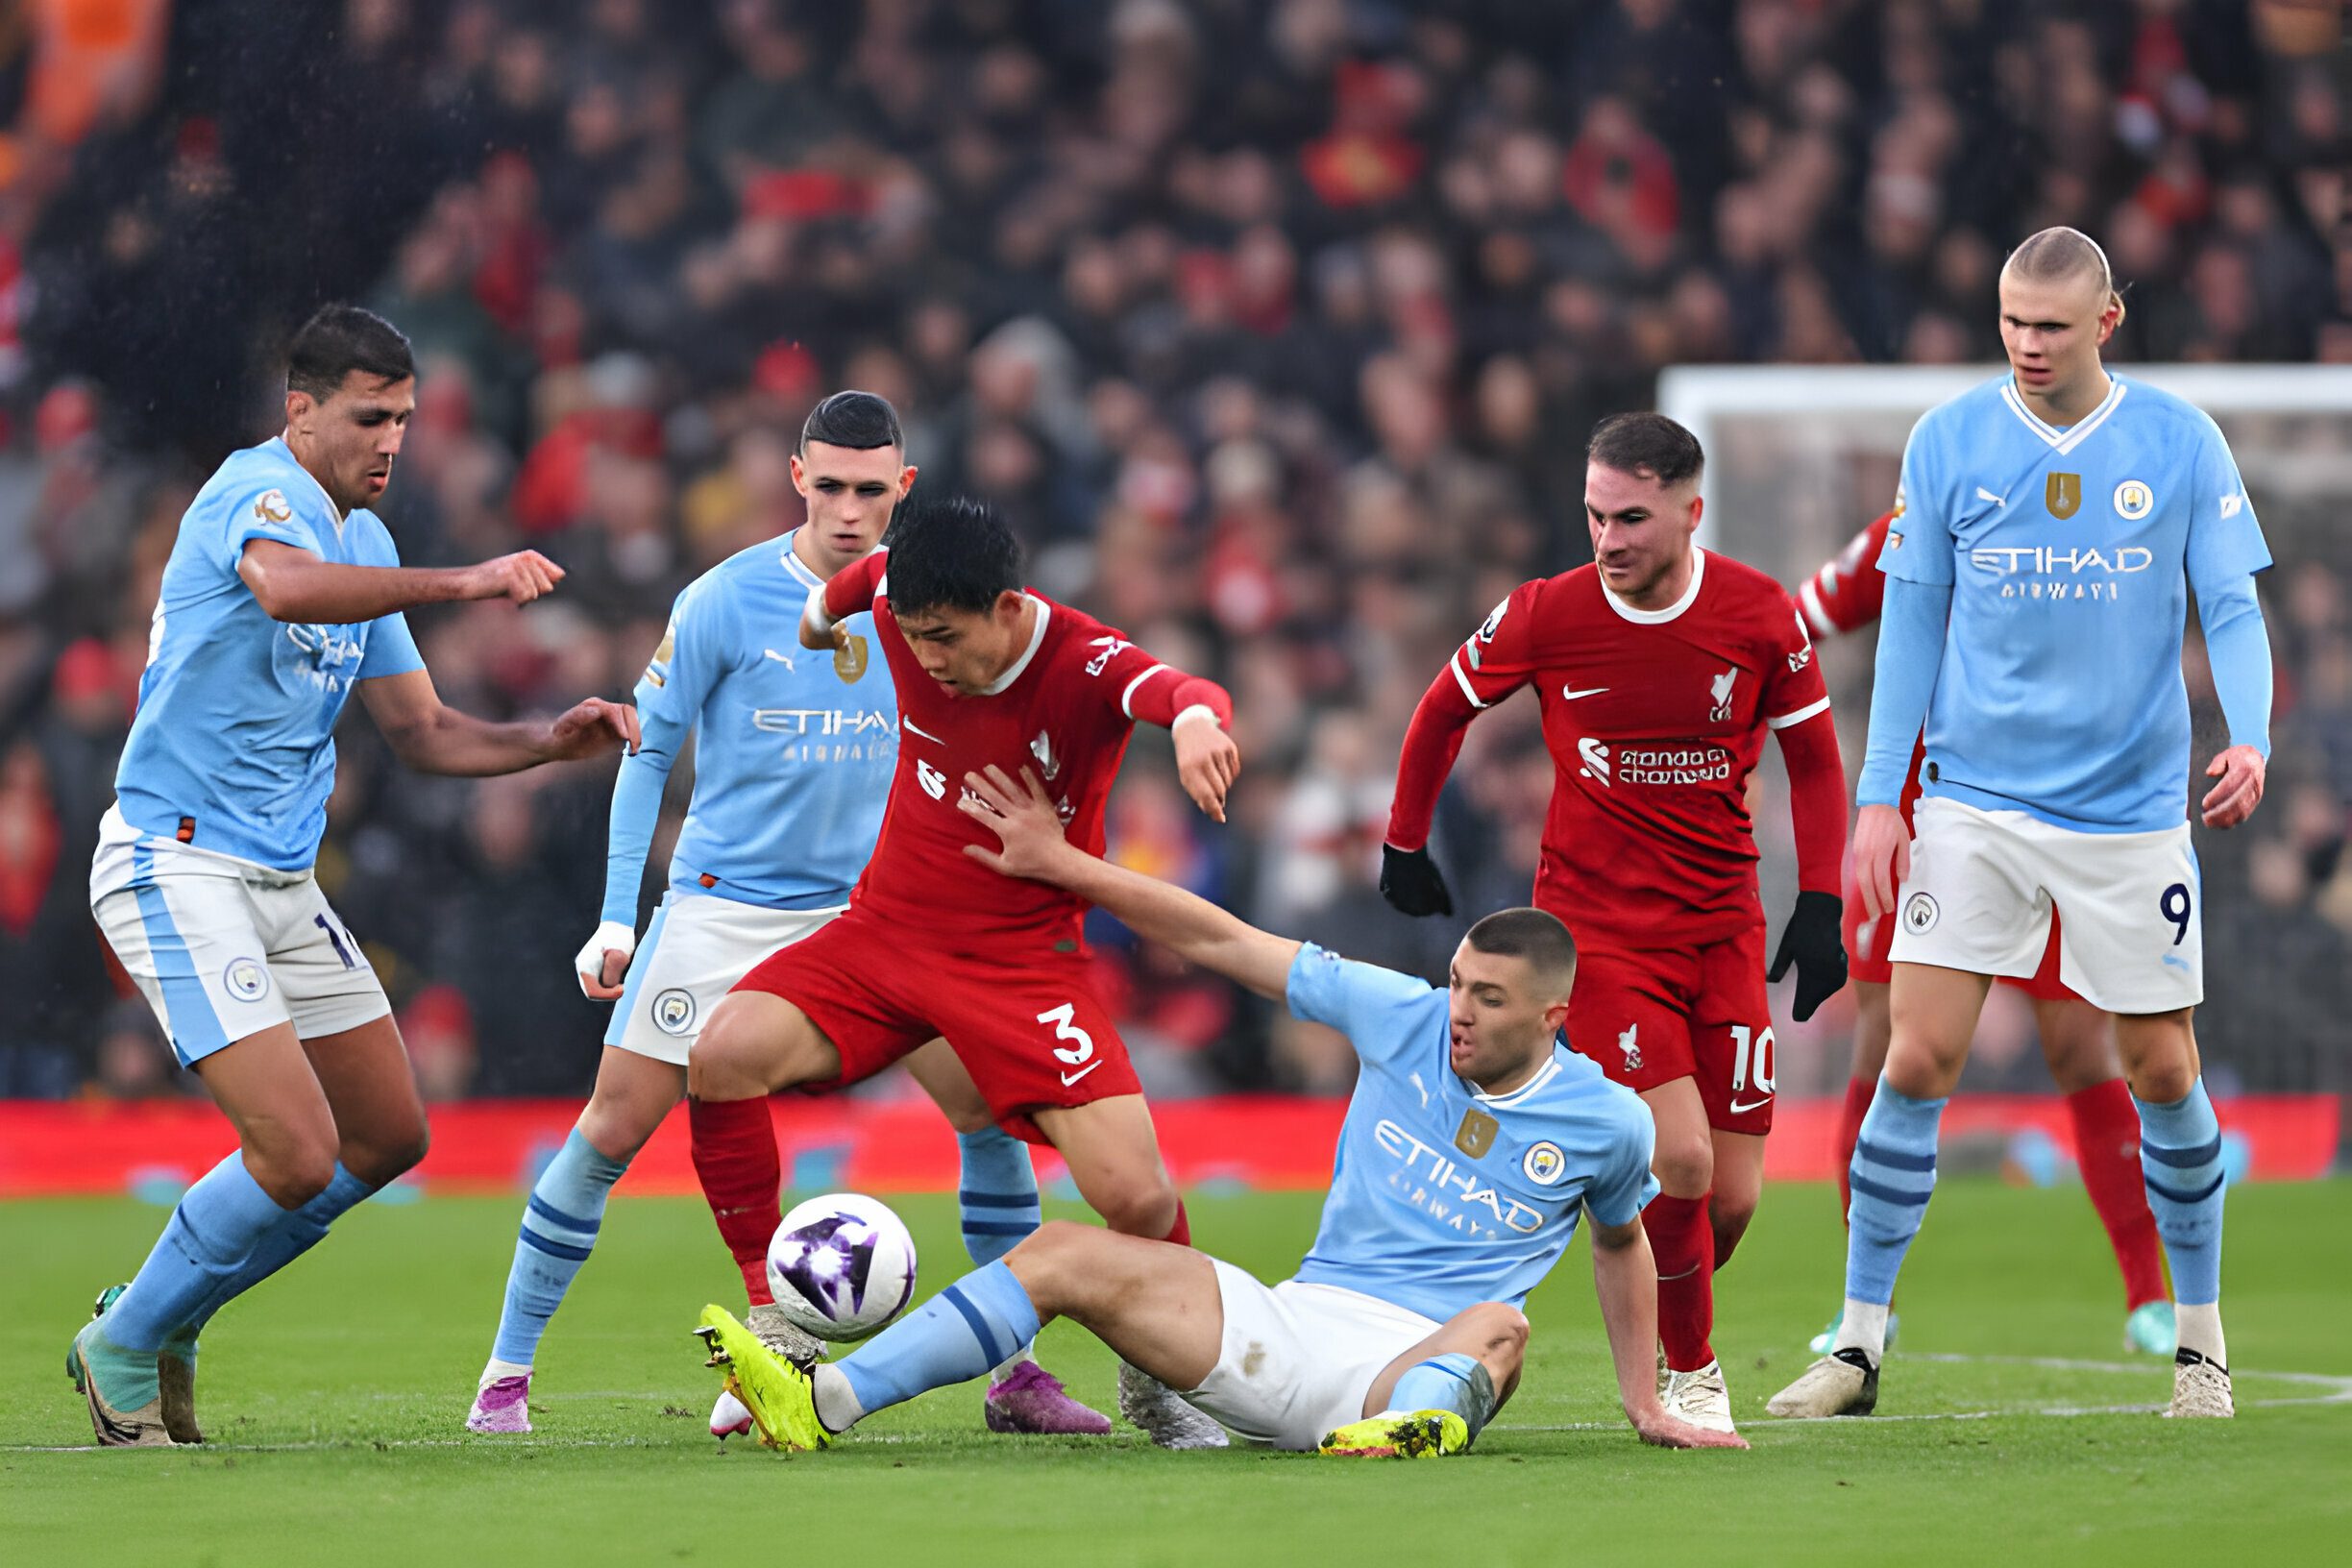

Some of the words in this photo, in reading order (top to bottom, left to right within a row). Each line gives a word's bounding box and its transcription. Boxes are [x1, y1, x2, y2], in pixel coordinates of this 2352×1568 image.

[1971, 546, 2153, 576] ETIHAD
[753, 708, 900, 738] ETIHA
[2159, 882, 2192, 946] 9
[1036, 1002, 1094, 1066] 3
[1729, 1025, 1776, 1094] 10
[1374, 1119, 1544, 1234] ETIHAD
